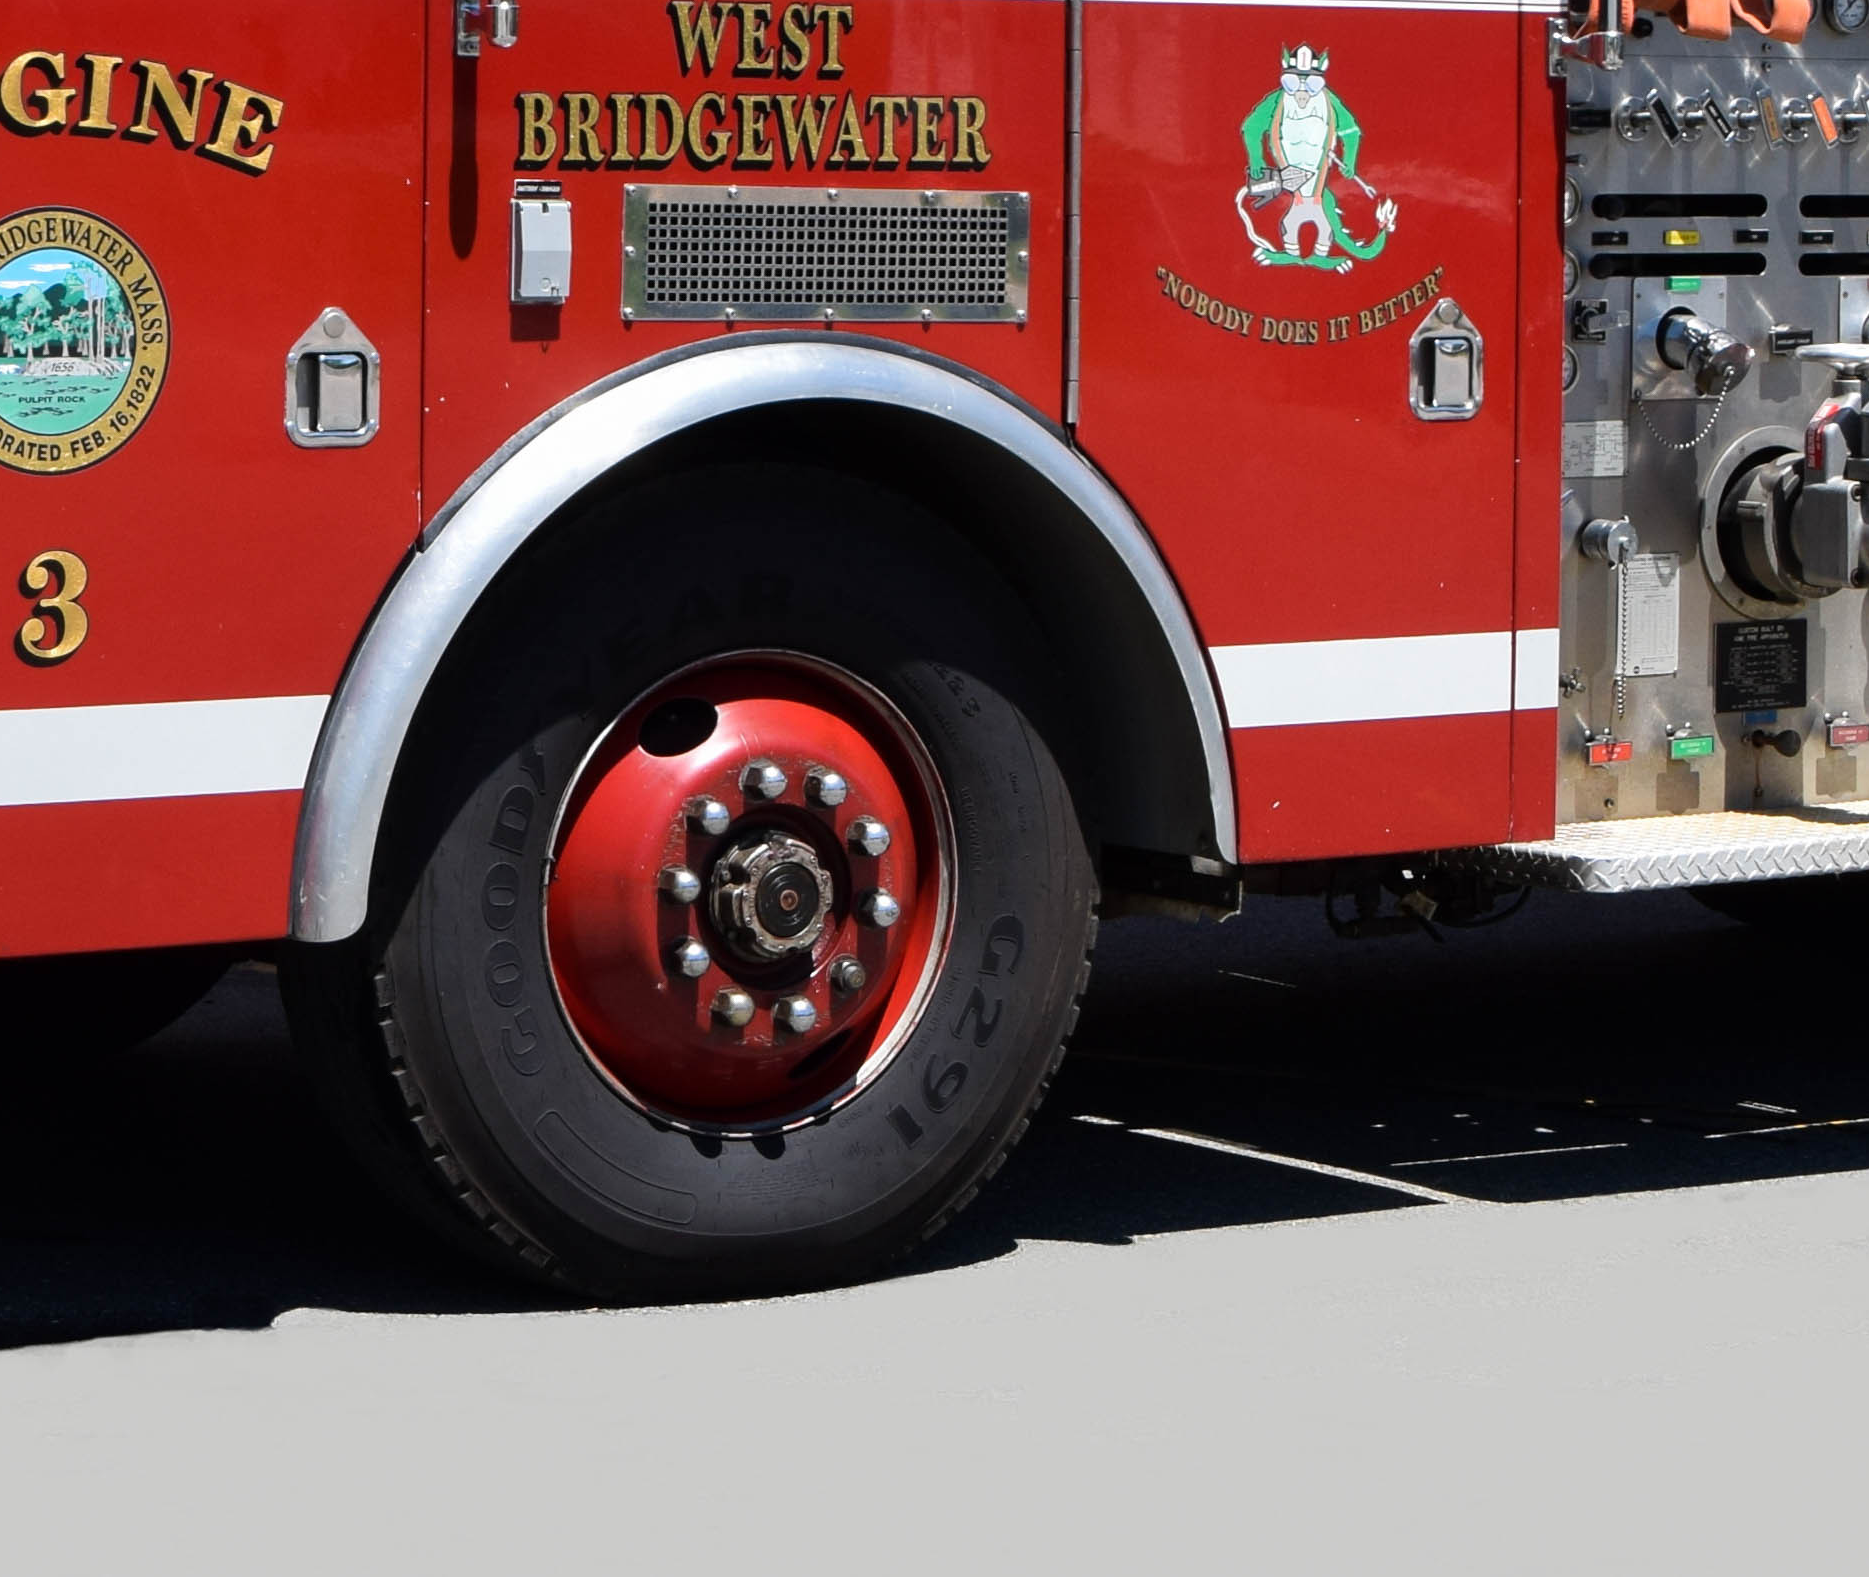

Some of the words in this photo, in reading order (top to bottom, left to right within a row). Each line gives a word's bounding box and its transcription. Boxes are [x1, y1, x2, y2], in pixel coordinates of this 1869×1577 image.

[666, 1, 854, 80] WEST
[514, 92, 992, 172] BRIDGEWATER
[127, 273, 164, 352] MASS.
[1261, 317, 1319, 344] DOES
[1327, 316, 1353, 343] IT
[18, 395, 54, 404] PULPIT
[56, 395, 86, 404] ROCK
[50, 361, 75, 373] 1656
[69, 429, 112, 459] FEB.
[126, 364, 156, 413] 1822
[11, 549, 90, 669] 3
[885, 912, 1026, 1147] G291
